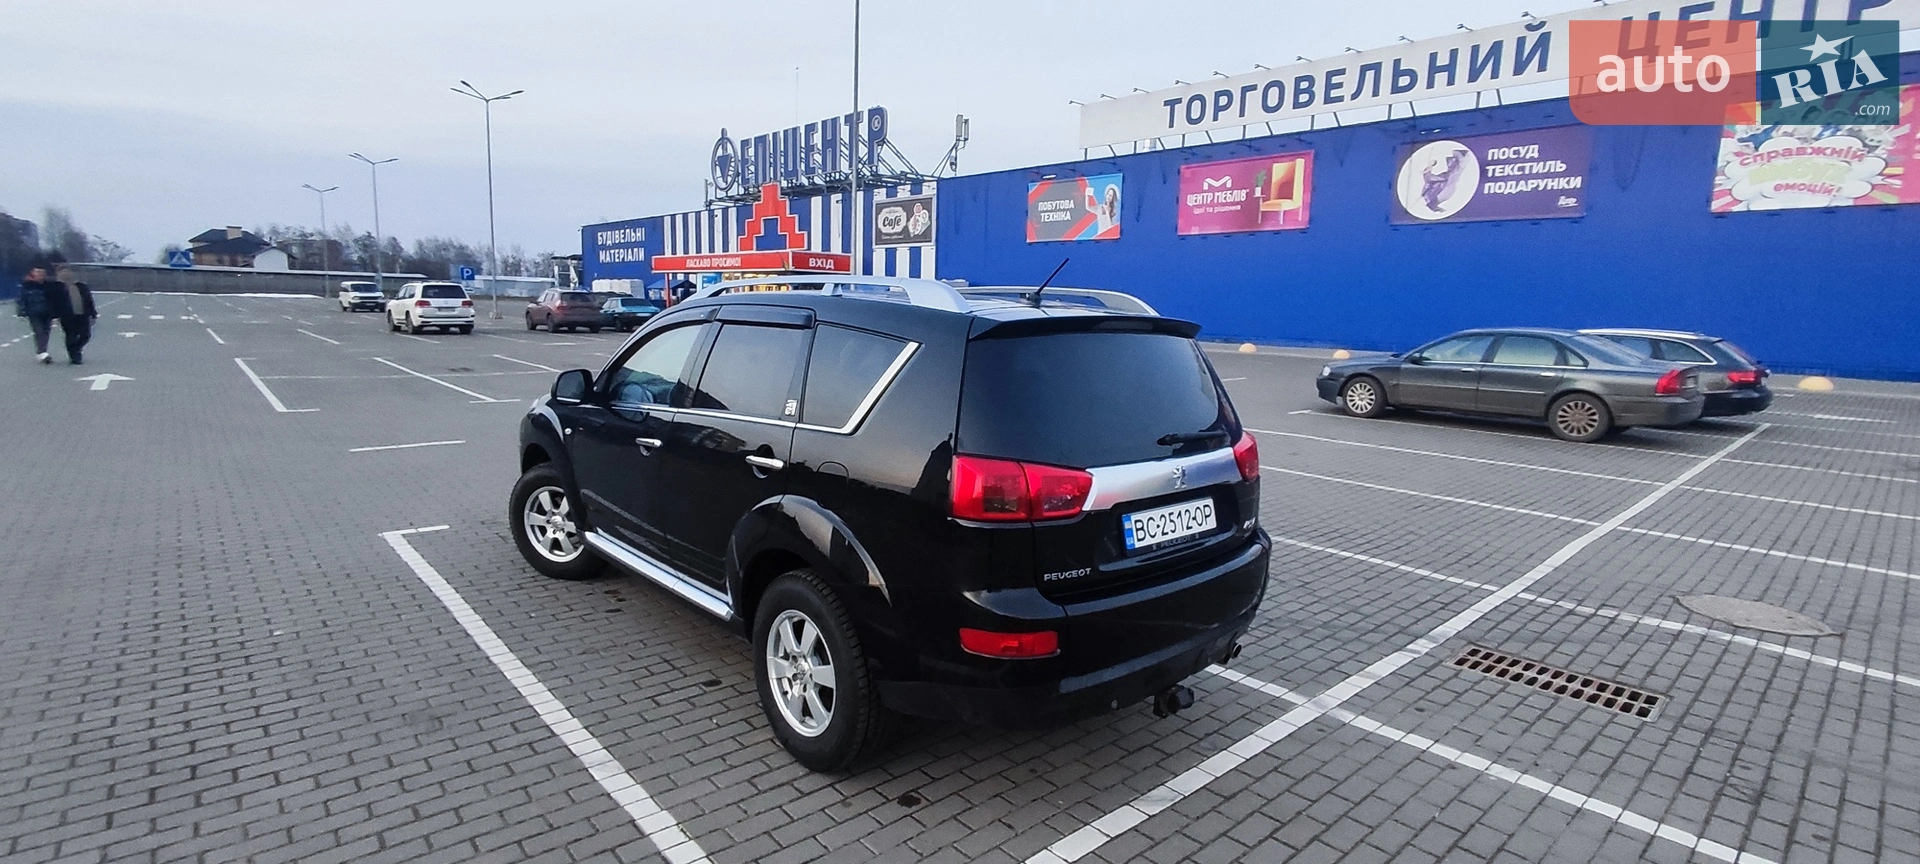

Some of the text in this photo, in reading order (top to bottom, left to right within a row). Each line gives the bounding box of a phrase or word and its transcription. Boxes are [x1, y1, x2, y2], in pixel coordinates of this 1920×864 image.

[1163, 20, 1553, 129] ТОРГОВЕЛЬНИЙ
[740, 107, 888, 187] ЕПІЦЕНТР
[1488, 144, 1539, 160] ПОСУД
[1485, 160, 1567, 177] ТЕКСТИЛЬ
[1483, 176, 1582, 195] ПОДАРУНКИ
[1038, 199, 1075, 211] ПОБУТОВА
[1187, 189, 1247, 206] ЦЕНТР МЕБЛІВ
[882, 214, 902, 230] Café
[1040, 211, 1071, 222] ТЕХНІКА
[597, 227, 646, 246] БУДІВЕЛЬНІ
[599, 247, 645, 263] МАТЕРІАЛИ
[685, 258, 711, 268] ЛАСКАВО
[808, 257, 836, 270] ВХІД
[1044, 567, 1092, 582] PEUGEOT
